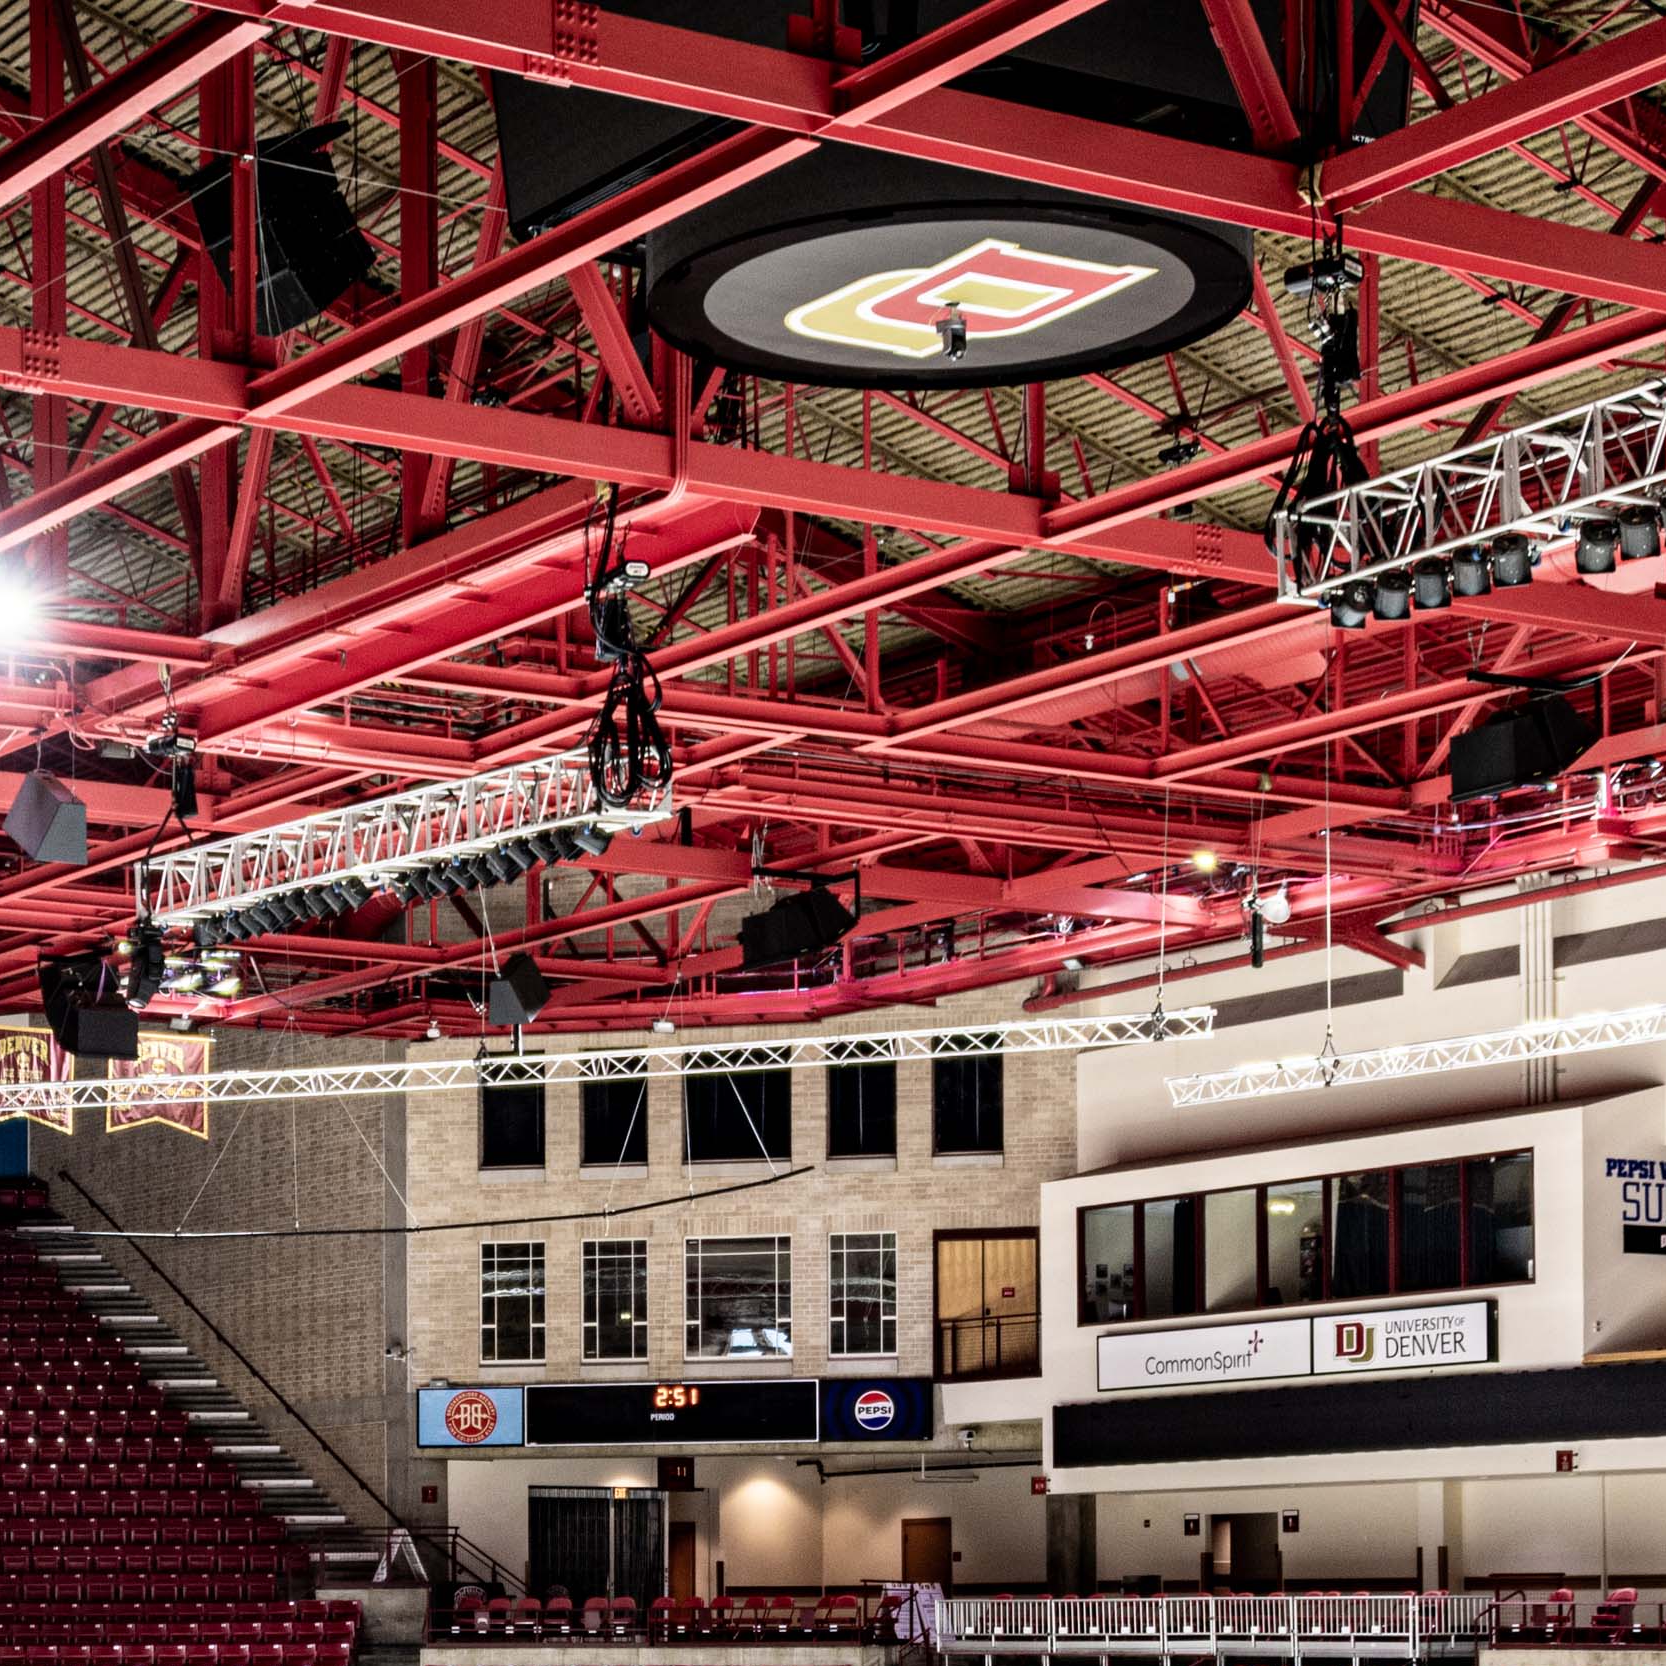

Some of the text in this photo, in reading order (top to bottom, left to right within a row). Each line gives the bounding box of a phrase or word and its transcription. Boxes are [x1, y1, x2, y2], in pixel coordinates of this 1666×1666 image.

[0, 1035, 48, 1066] DENVER
[1606, 1158, 1654, 1179] PEPSI
[1385, 1316, 1465, 1334] UNIVERSITY OF
[1385, 1332, 1466, 1358] DENVER
[1145, 1351, 1253, 1376] CommonSpirit
[654, 1386, 700, 1408] 2:51
[650, 1413, 675, 1421] PERIOD
[858, 1406, 892, 1415] PEPSI
